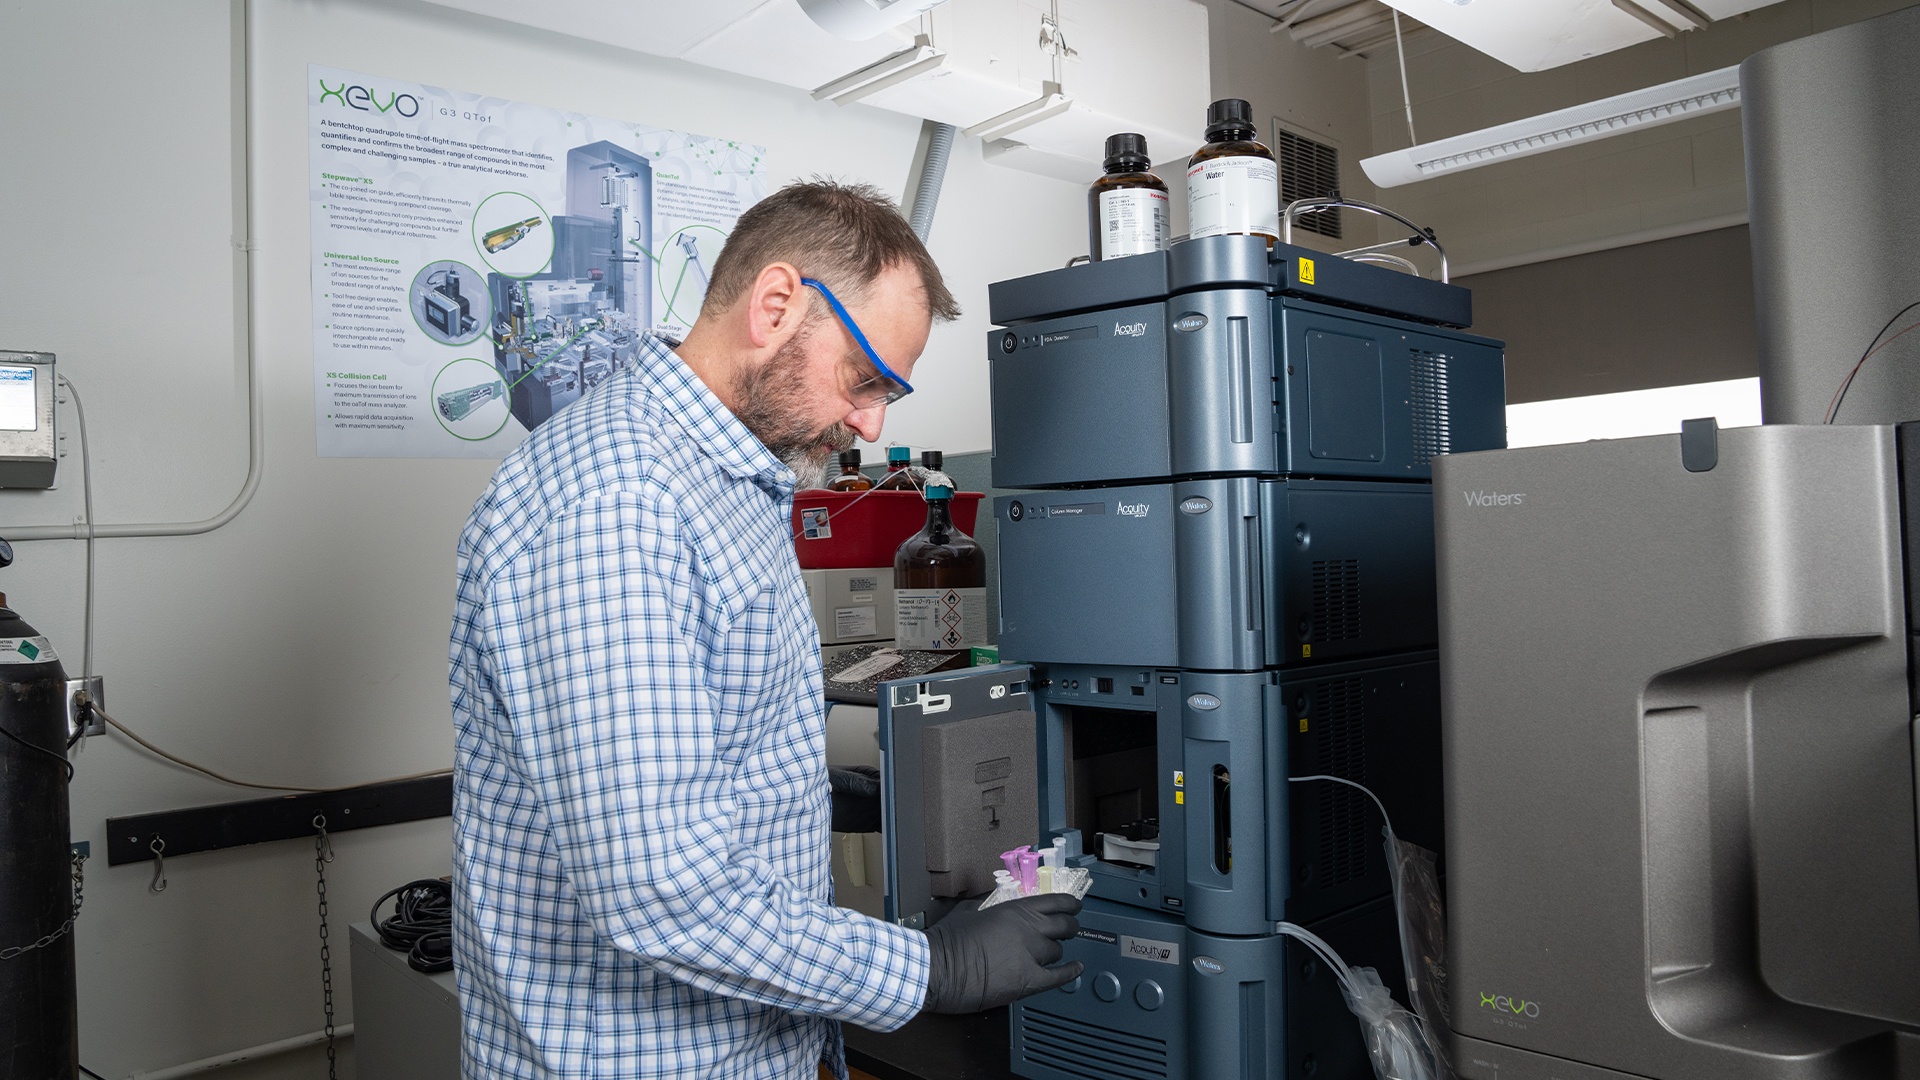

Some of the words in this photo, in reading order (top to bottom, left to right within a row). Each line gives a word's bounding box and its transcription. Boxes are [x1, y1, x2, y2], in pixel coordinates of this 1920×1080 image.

[440, 108, 456, 117] G3
[464, 112, 491, 123] QTof
[328, 120, 364, 132] bentchtop
[366, 126, 404, 138] quadrupole
[406, 132, 449, 145] time-of-flight
[469, 143, 510, 155] spectrometer
[321, 132, 356, 142] quantifies
[373, 139, 402, 149] confirms
[416, 145, 445, 155] broadest
[446, 151, 465, 159] range
[474, 155, 511, 165] compounds
[321, 143, 351, 152] complex
[368, 150, 407, 162] challenging
[408, 156, 436, 165] samples
[462, 163, 492, 173] analytical
[494, 168, 528, 178] workhorse.
[656, 172, 680, 180] QuanTof
[1206, 171, 1224, 180] Water
[369, 198, 397, 206] increasing
[396, 192, 421, 201] efficiently
[448, 198, 471, 207] thermally
[342, 206, 372, 215] redesigned
[330, 214, 358, 222] sensitivity
[368, 218, 399, 227] challenging
[400, 222, 431, 230] compounds
[380, 228, 405, 236] analytical
[324, 252, 360, 260] Universal
[374, 257, 400, 265] Source
[1114, 322, 1147, 336] Acquity
[1182, 320, 1203, 328] Waters
[1117, 501, 1149, 517] Acquity
[932, 640, 940, 648] M
[1193, 697, 1215, 706] Waters
[1098, 934, 1115, 942] Manager
[1130, 940, 1162, 960] Acquity
[1200, 959, 1220, 970] Waters
